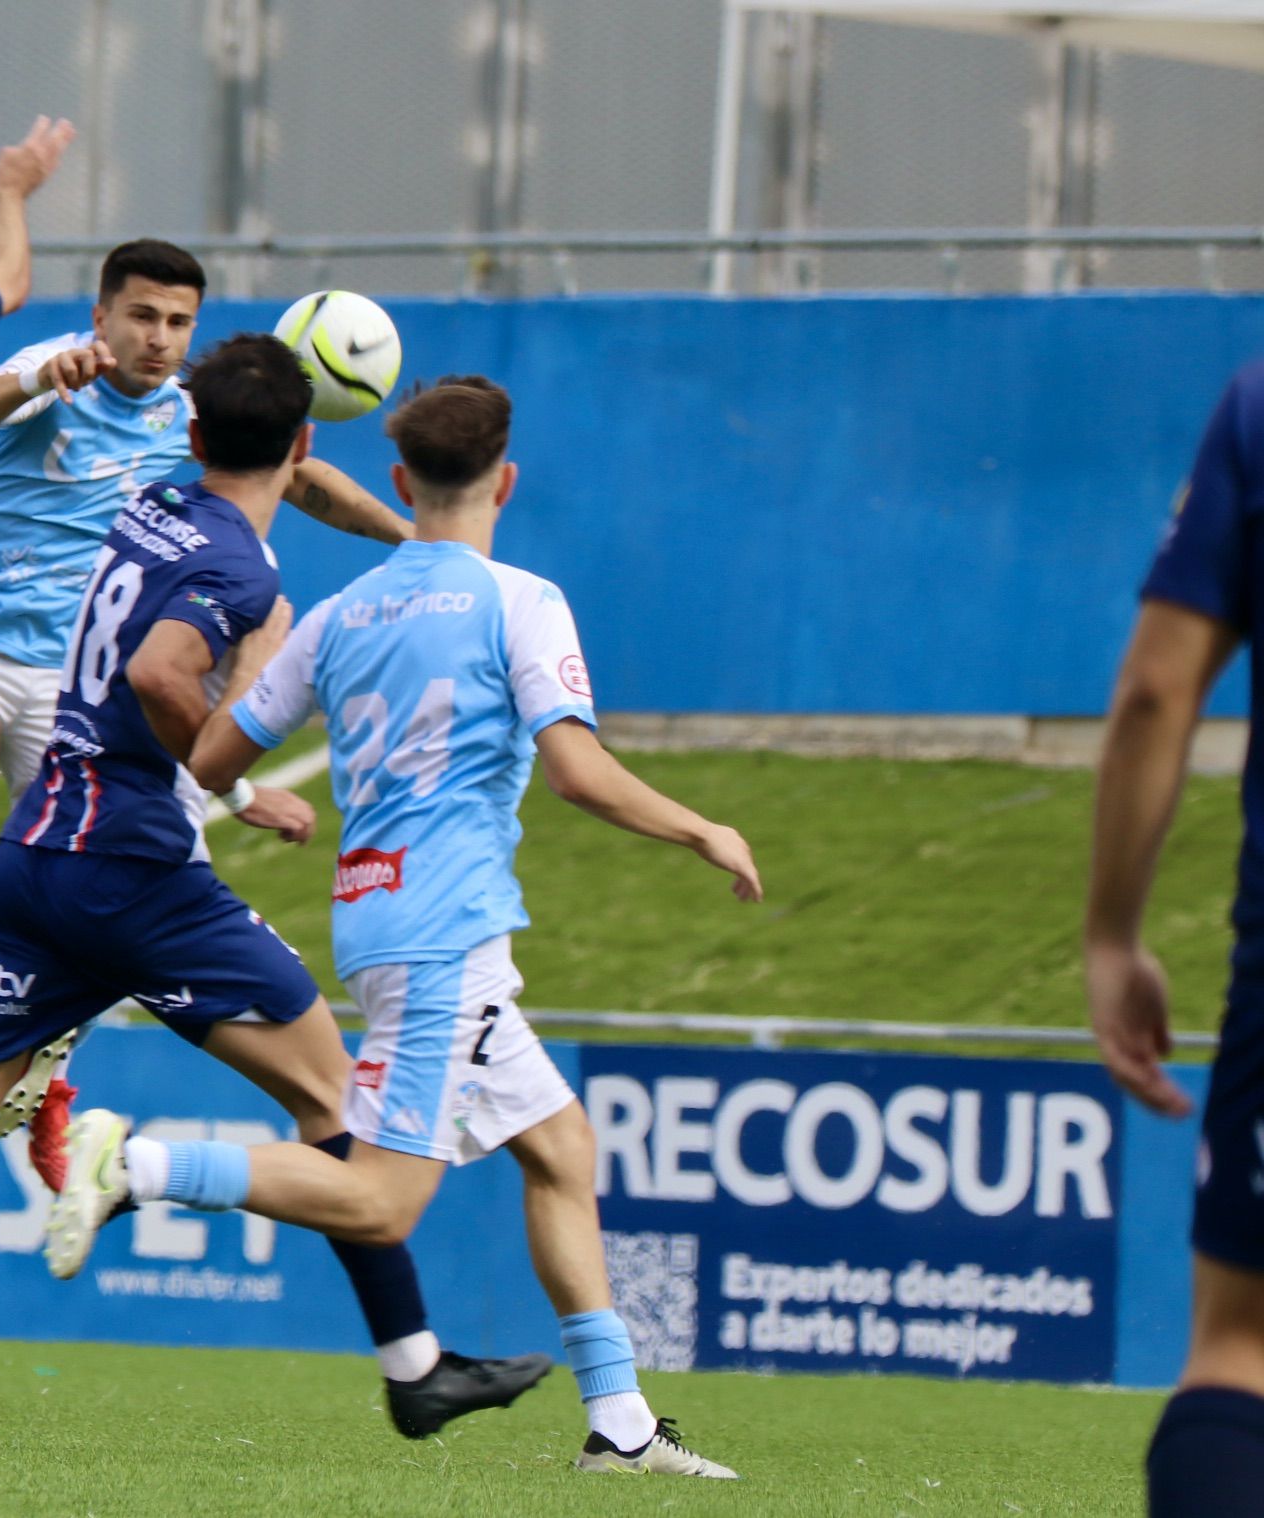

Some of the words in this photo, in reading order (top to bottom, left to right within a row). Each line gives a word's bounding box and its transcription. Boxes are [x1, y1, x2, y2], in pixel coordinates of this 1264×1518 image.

[58, 545, 144, 707] 18
[342, 678, 455, 806] 24
[471, 1004, 500, 1066] 2
[584, 1074, 1113, 1220] RECOSUR
[722, 1252, 892, 1310] Expertos
[895, 1259, 1093, 1317] dedicados
[720, 1310, 747, 1349] a
[748, 1303, 856, 1356] darte
[859, 1305, 900, 1358] lo
[902, 1312, 1017, 1374] mejor
